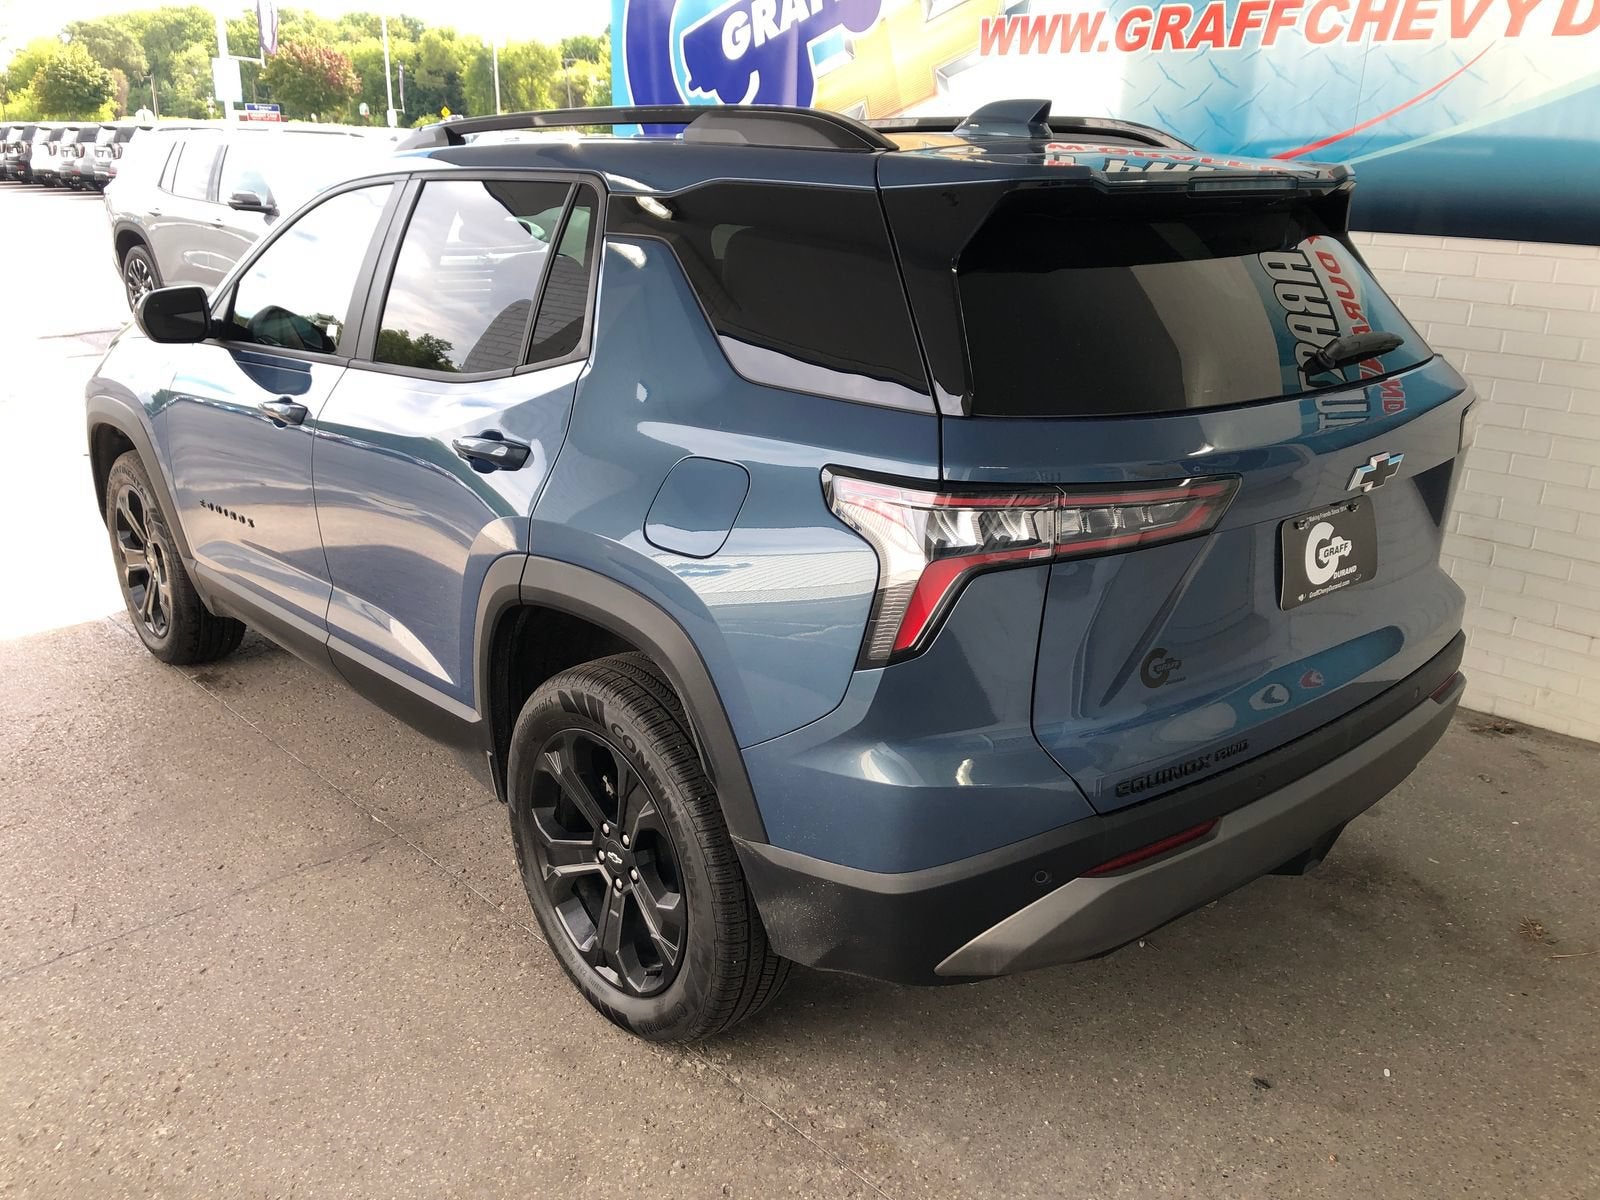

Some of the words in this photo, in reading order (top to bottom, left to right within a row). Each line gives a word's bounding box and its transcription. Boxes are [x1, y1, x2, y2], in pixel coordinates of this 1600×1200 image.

[722, 0, 824, 60] GRA
[1323, 542, 1349, 559] GRAFF
[1333, 565, 1358, 579] DURAND
[1115, 754, 1212, 797] EQUINOX
